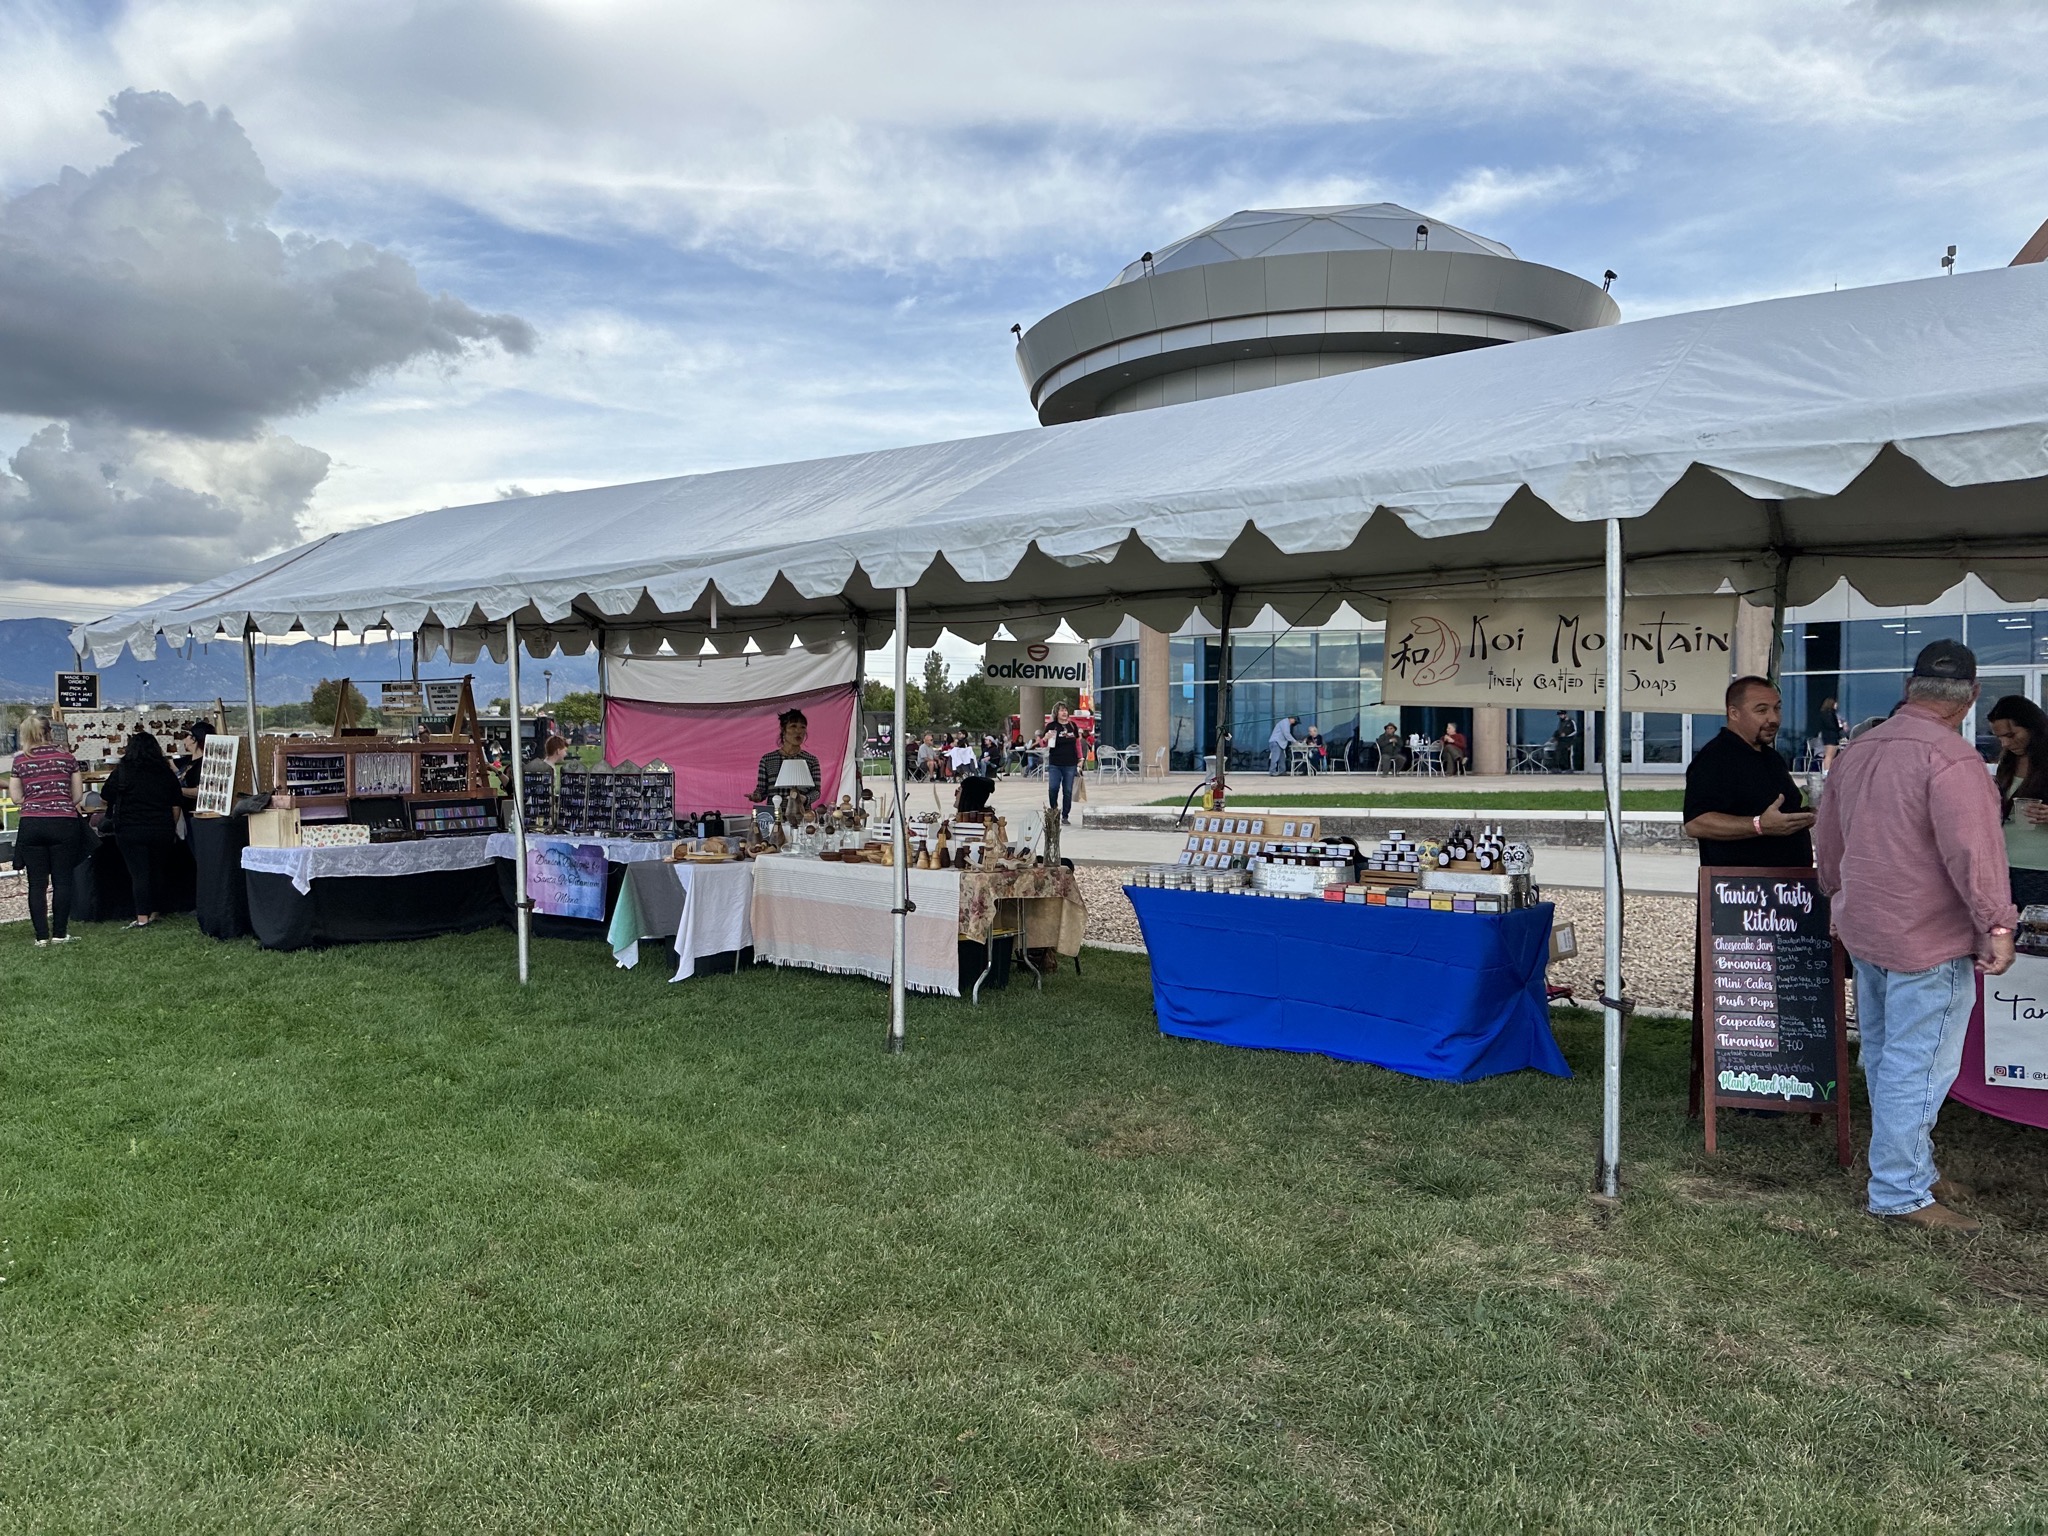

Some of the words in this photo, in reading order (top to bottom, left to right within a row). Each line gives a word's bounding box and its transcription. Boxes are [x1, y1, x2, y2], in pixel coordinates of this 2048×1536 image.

[1391, 633, 1430, 679] 和
[987, 659, 1086, 681] oakenwell
[1715, 882, 1768, 907] Tania's
[1774, 882, 1814, 914] Tasty
[1742, 908, 1798, 932] Kitchen
[1714, 937, 1754, 953] Cheesecake
[1756, 938, 1774, 952] Jars
[1716, 957, 1773, 971] Brownies
[1715, 976, 1742, 989] Mini
[1744, 977, 1773, 991] Cakes
[1716, 995, 1746, 1007] Push
[1747, 996, 1775, 1011] Pops
[1716, 1014, 1776, 1030] Cupcakes
[1717, 1033, 1775, 1049] Tiramisu
[1719, 1072, 1748, 1090] Plant
[1749, 1073, 1776, 1094] Based
[1779, 1075, 1813, 1100] Options
